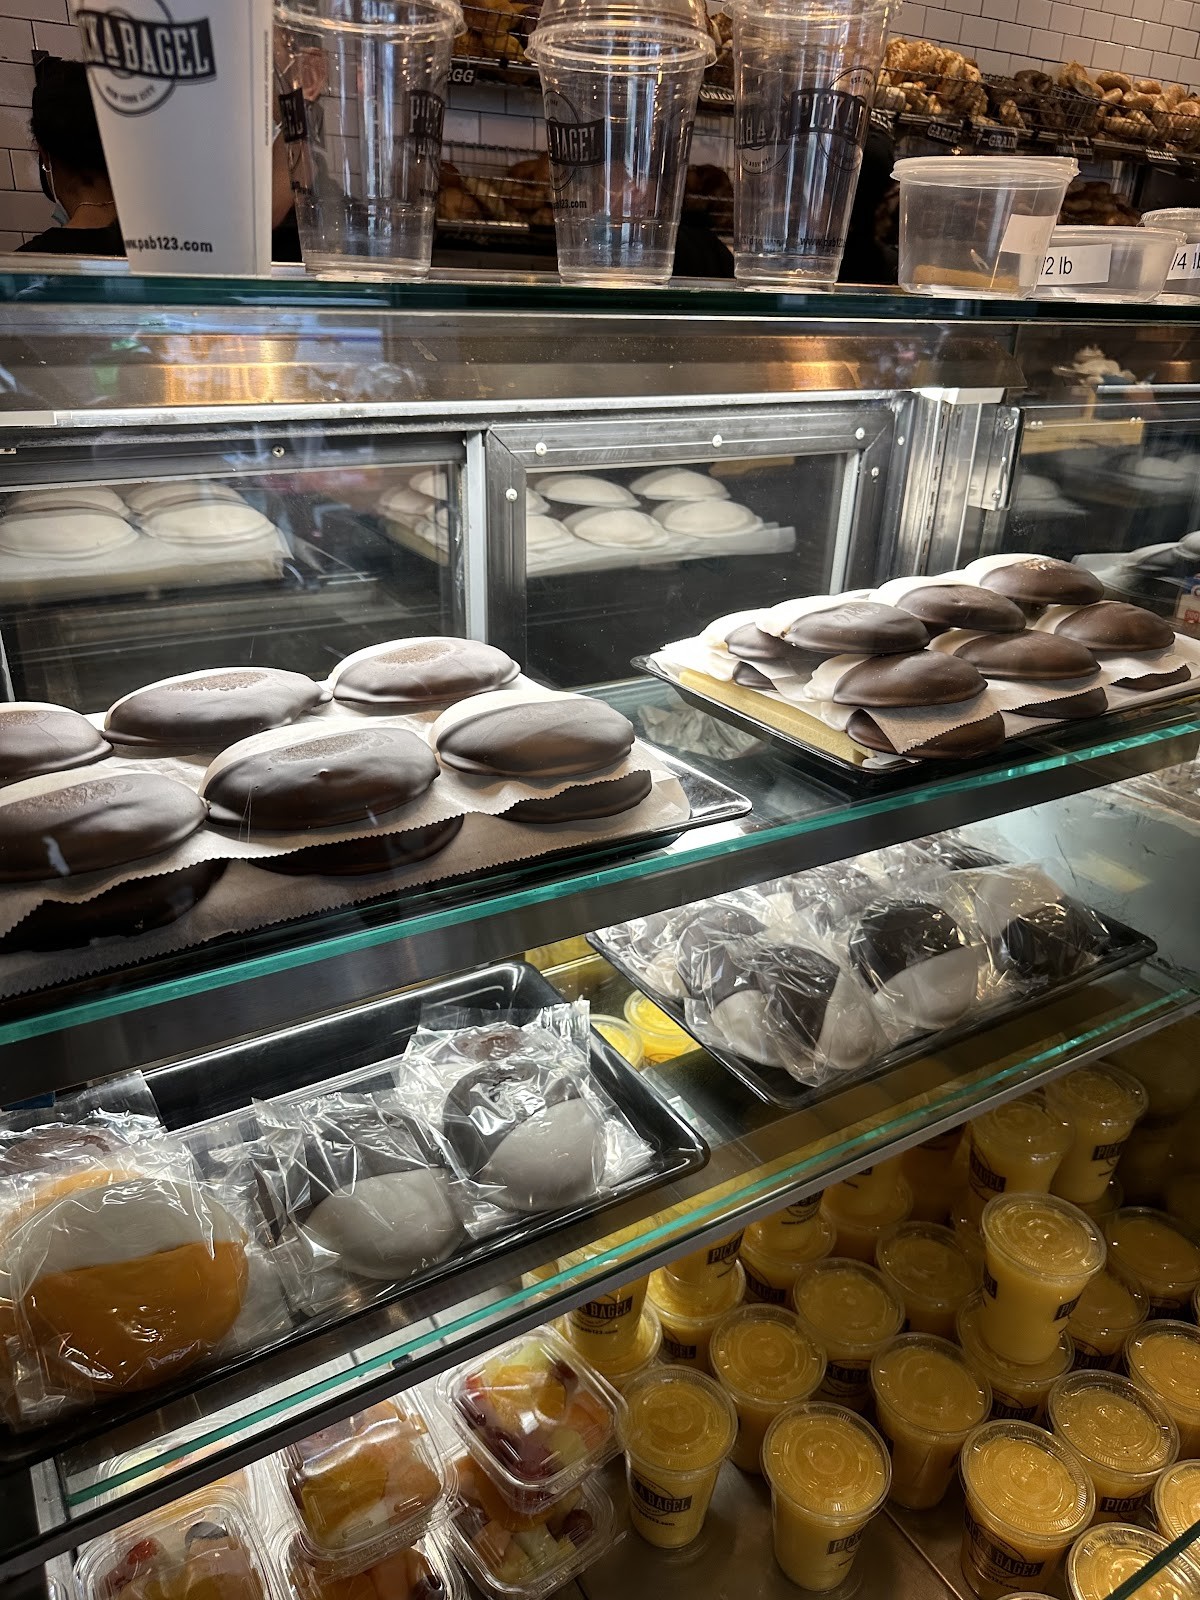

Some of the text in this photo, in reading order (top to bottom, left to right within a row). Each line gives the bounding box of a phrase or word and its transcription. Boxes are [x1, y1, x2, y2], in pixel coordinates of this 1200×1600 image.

[118, 20, 211, 77] BAGEL
[975, 132, 1017, 150] 7-GRAIN
[1059, 256, 1073, 275] lb
[590, 1301, 631, 1319] BAGEL
[648, 1492, 688, 1513] BAGEL
[1104, 1498, 1138, 1513] PICK
[995, 1552, 1040, 1576] BAGEL
